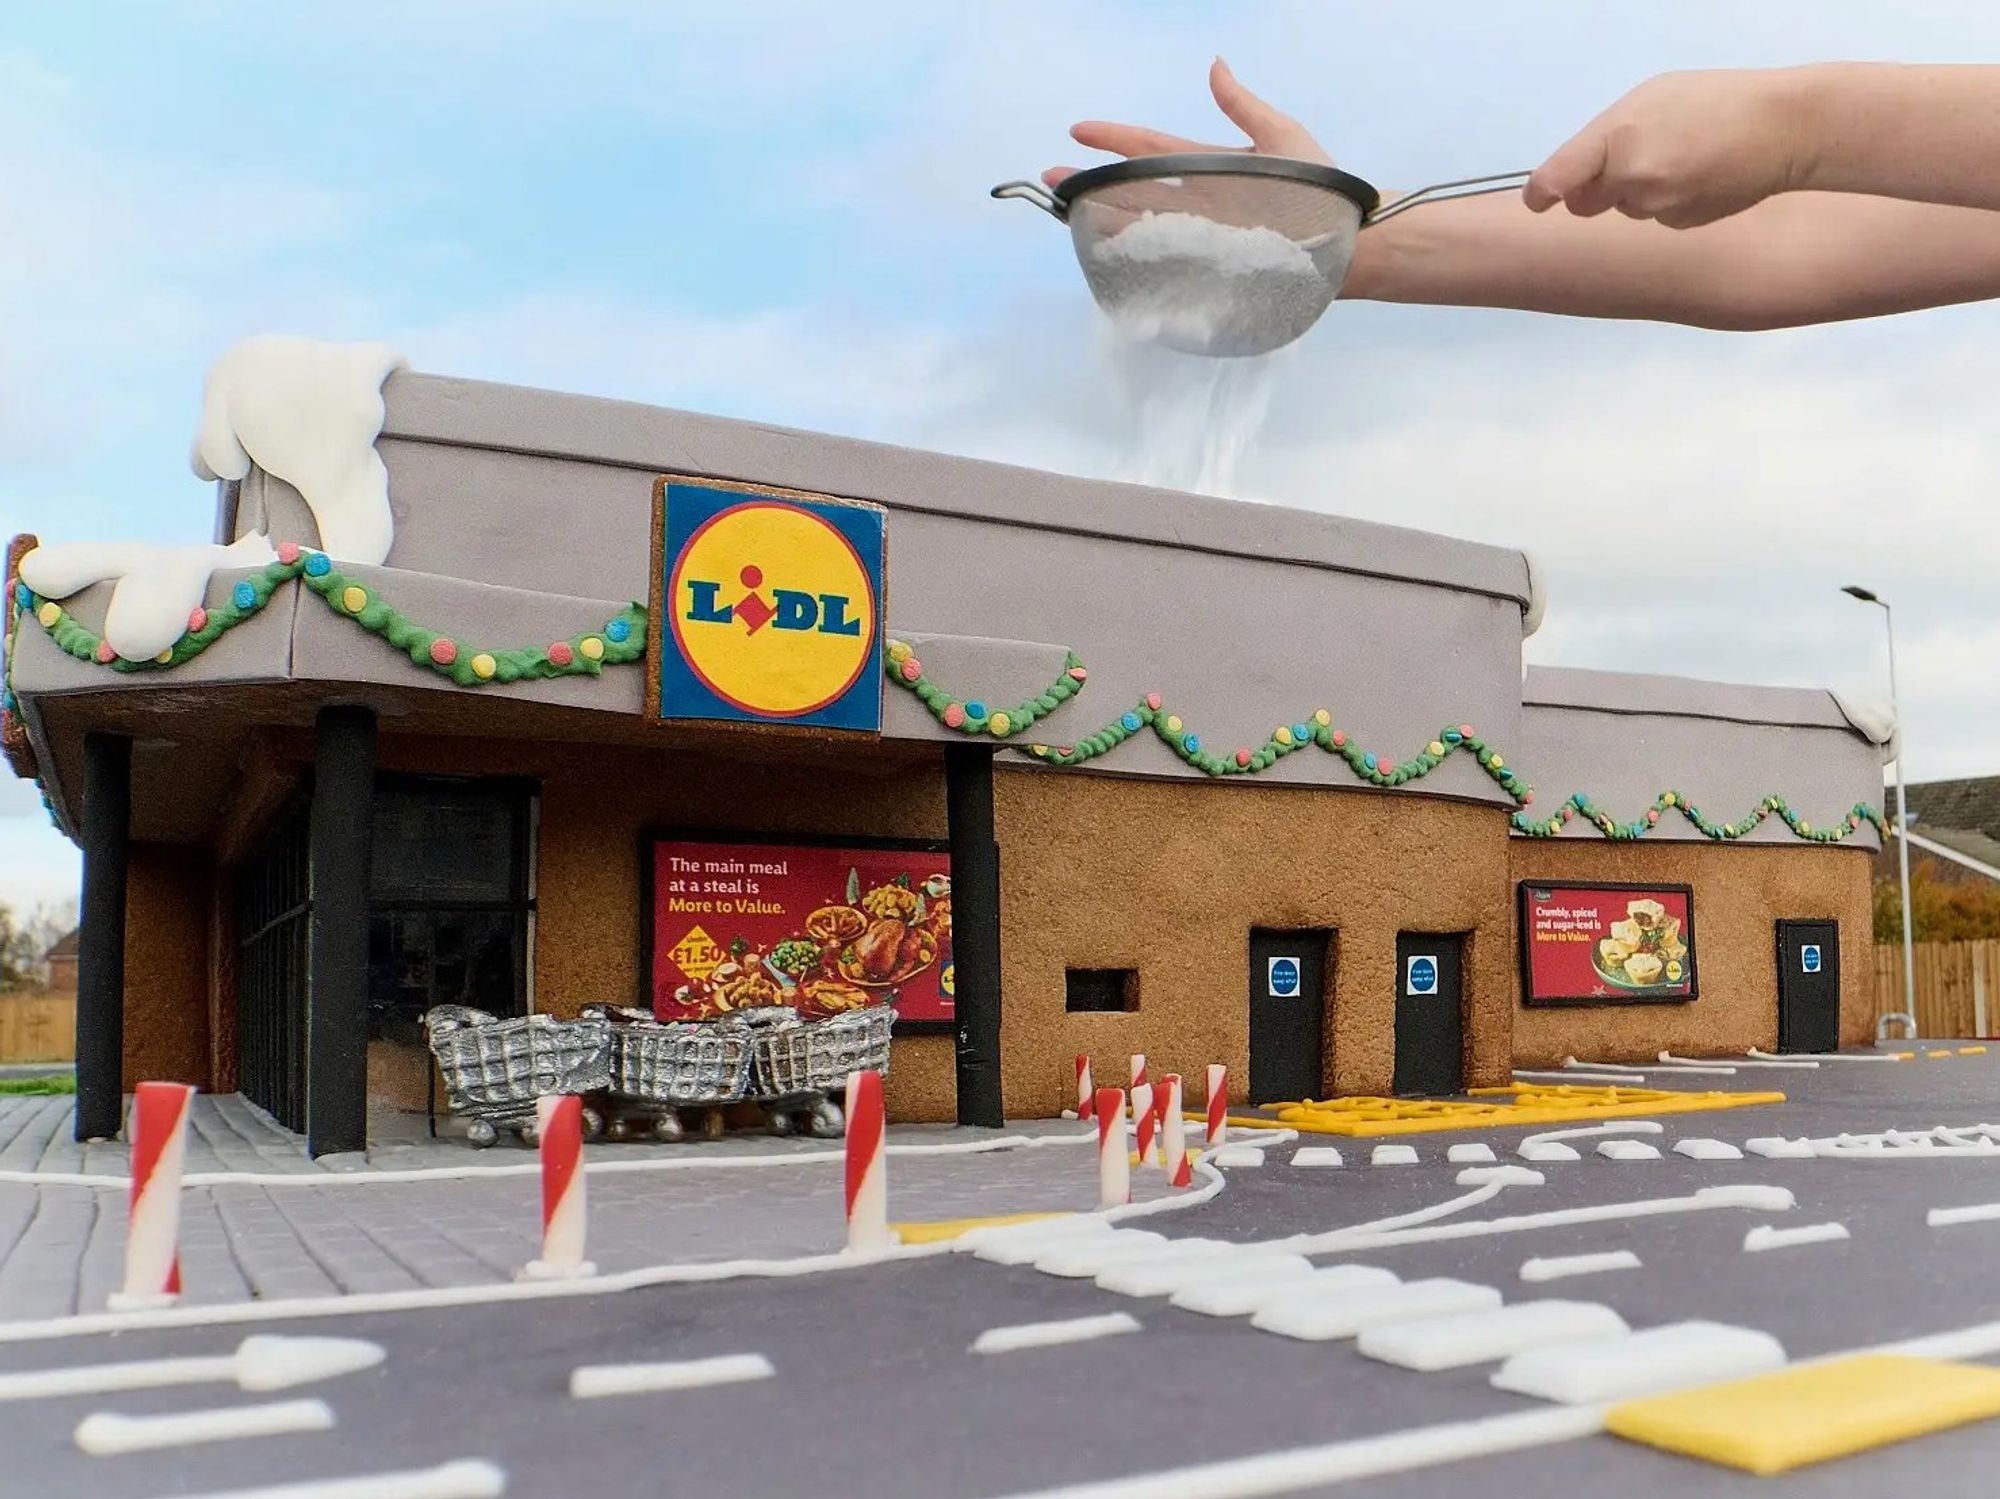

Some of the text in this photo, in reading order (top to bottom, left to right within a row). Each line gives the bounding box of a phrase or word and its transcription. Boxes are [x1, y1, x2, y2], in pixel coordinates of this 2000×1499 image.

[670, 857, 788, 875] The main meal
[669, 879, 760, 894] at a steal is
[669, 898, 786, 914] More to Value.
[1536, 907, 1598, 920] Crumbly, spiced
[1536, 920, 1552, 929] and
[1595, 920, 1602, 929] is
[1537, 932, 1591, 941] More to Value.
[673, 945, 720, 964] £1.50
